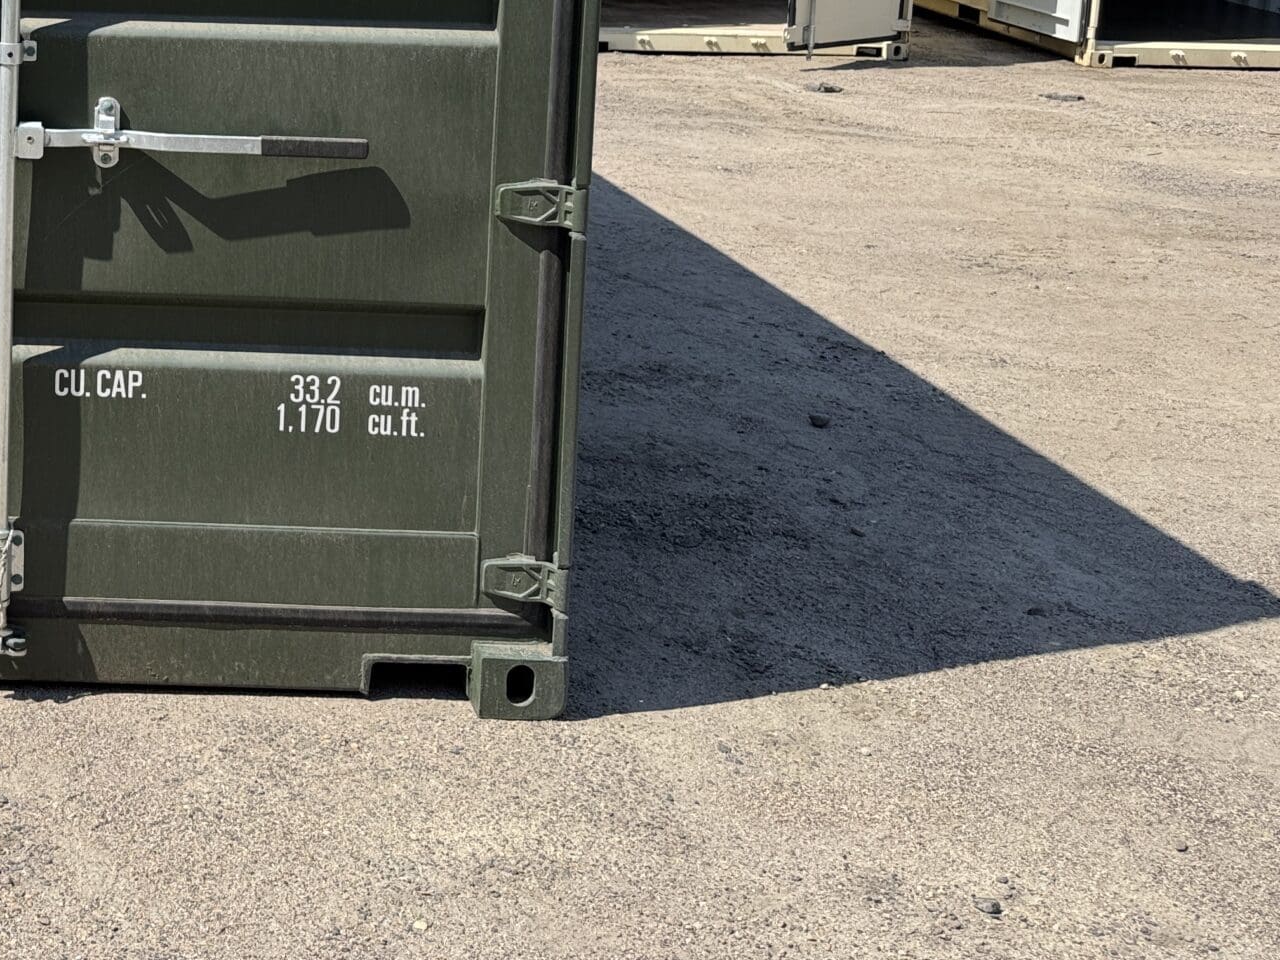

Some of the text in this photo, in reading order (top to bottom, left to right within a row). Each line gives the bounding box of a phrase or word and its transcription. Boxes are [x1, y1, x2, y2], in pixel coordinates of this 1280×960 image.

[290, 374, 341, 404] 33.2
[369, 384, 426, 408] cu.m.
[277, 403, 425, 437] 1,170 cu.ft.
